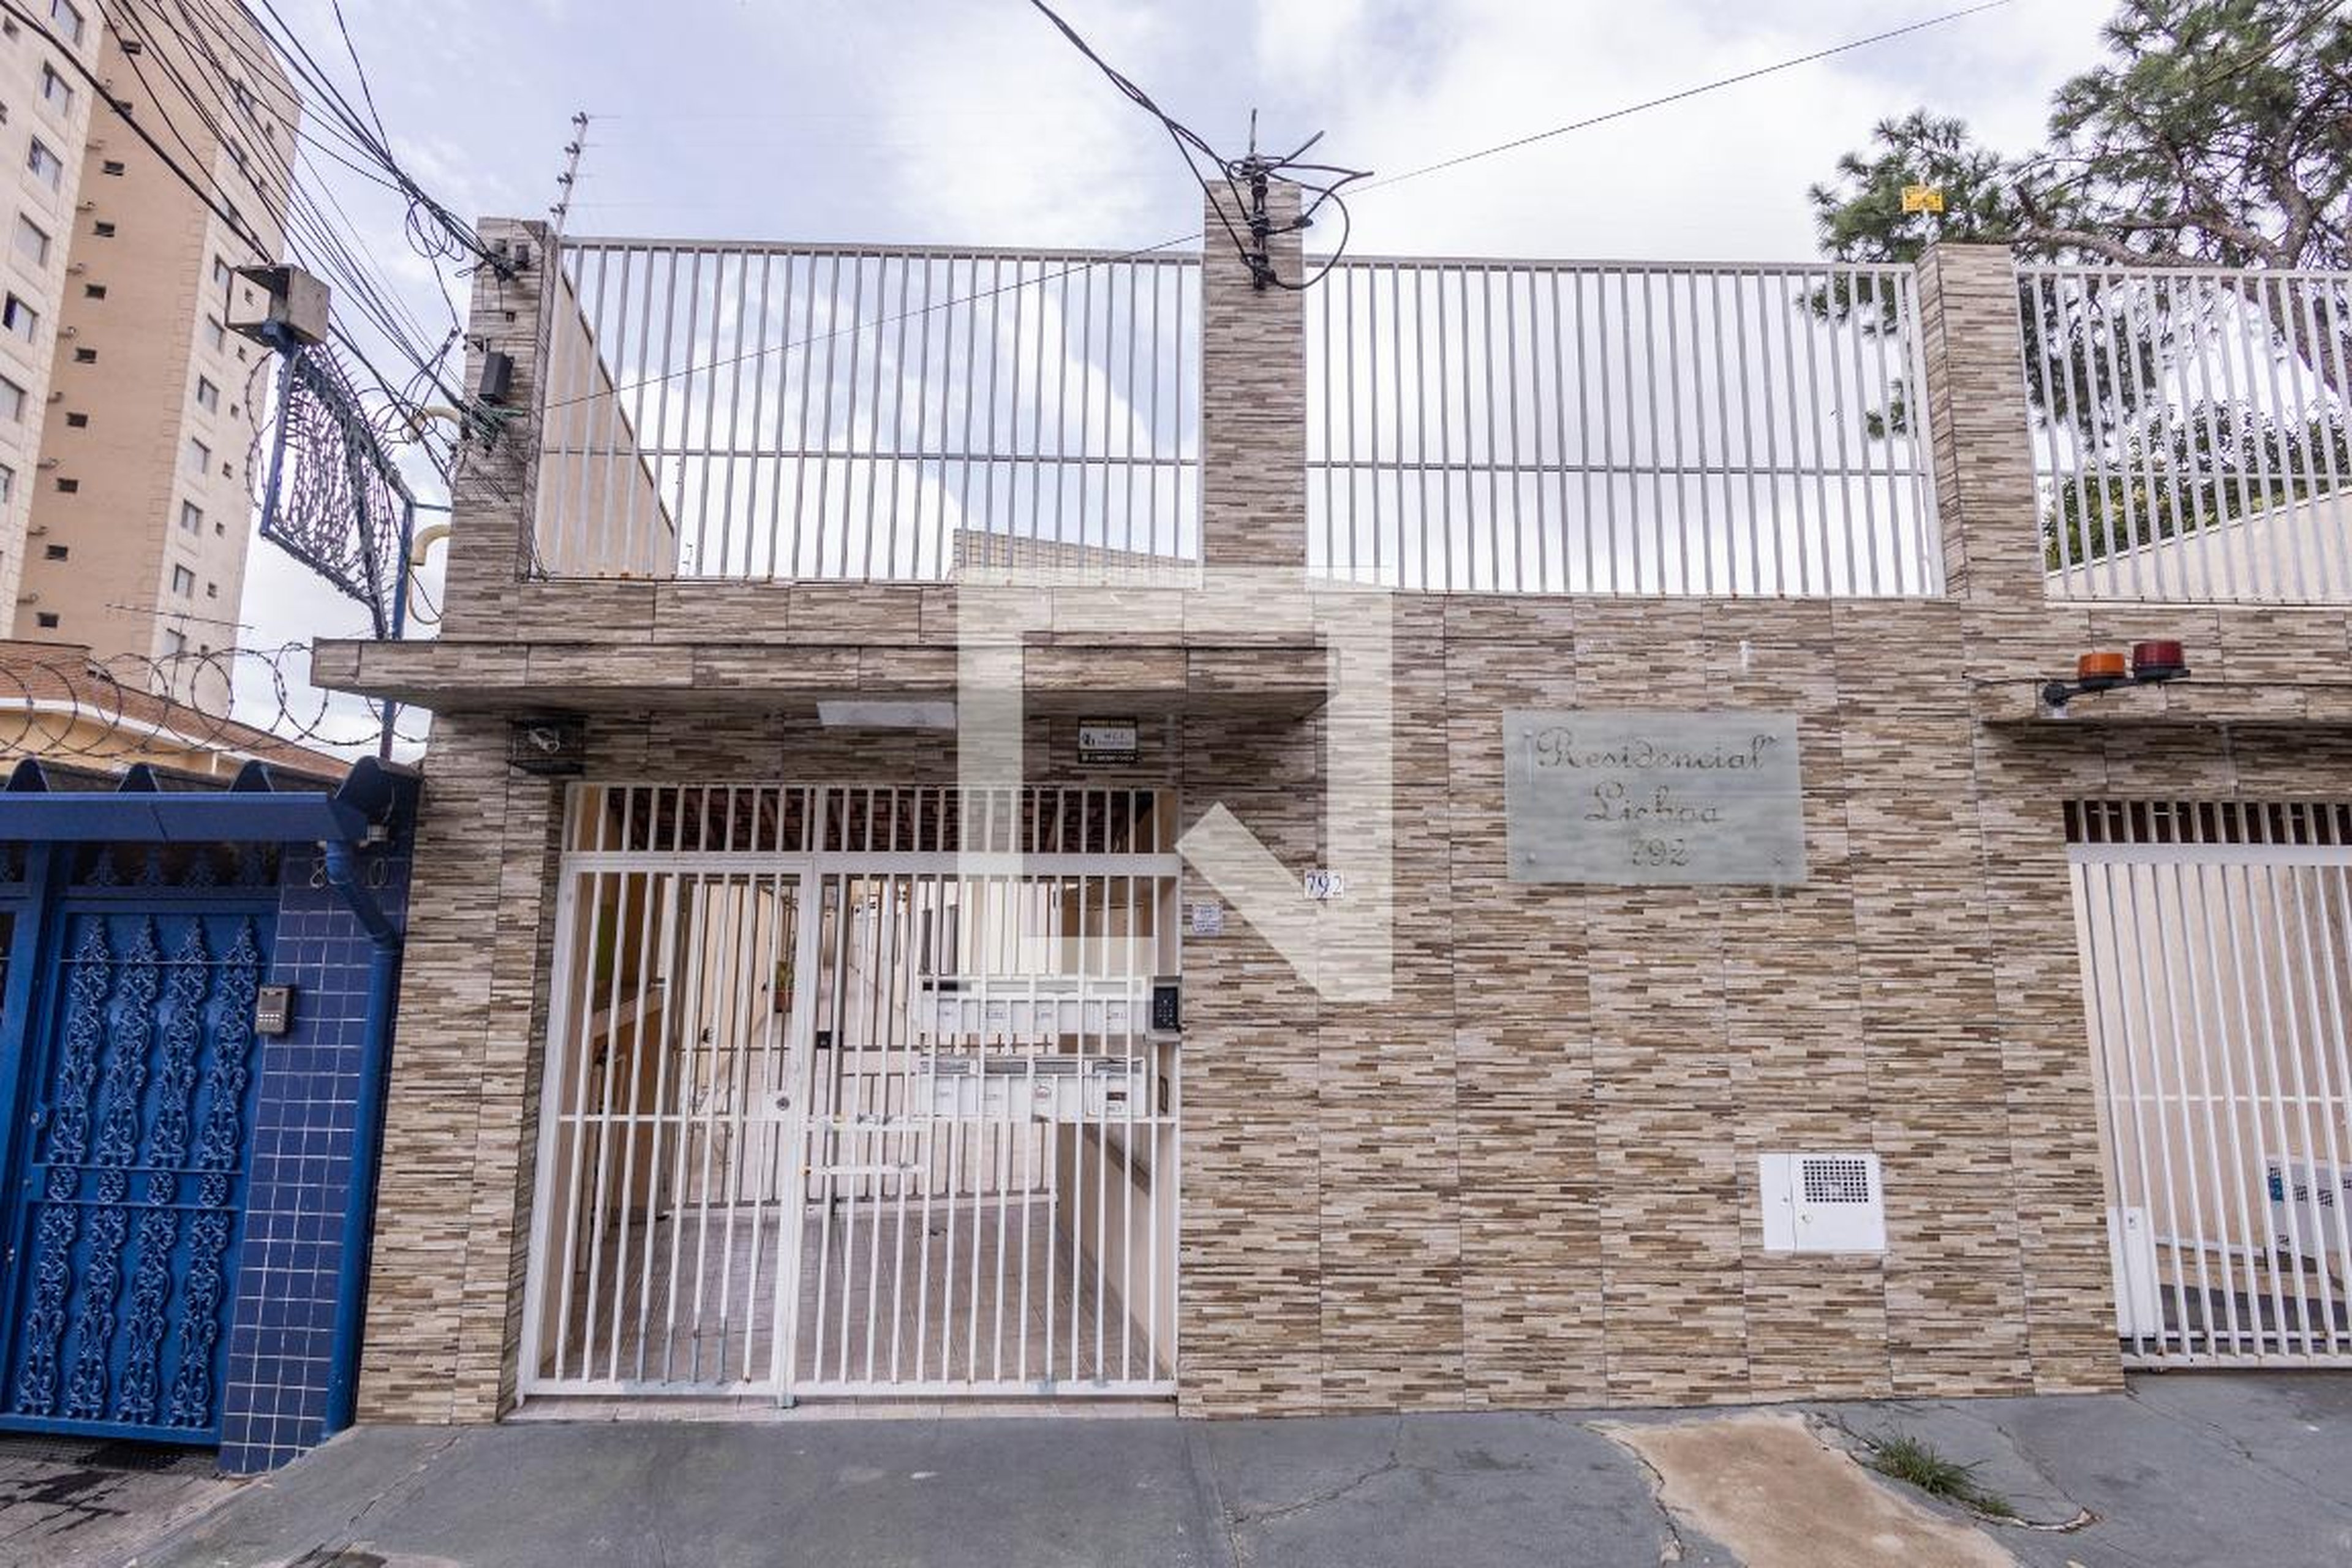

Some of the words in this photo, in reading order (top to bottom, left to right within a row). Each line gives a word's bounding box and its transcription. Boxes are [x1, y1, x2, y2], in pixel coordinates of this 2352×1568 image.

[1536, 726, 1778, 769] Residencial
[1631, 839, 1689, 866] 792
[1306, 871, 1342, 898] 792
